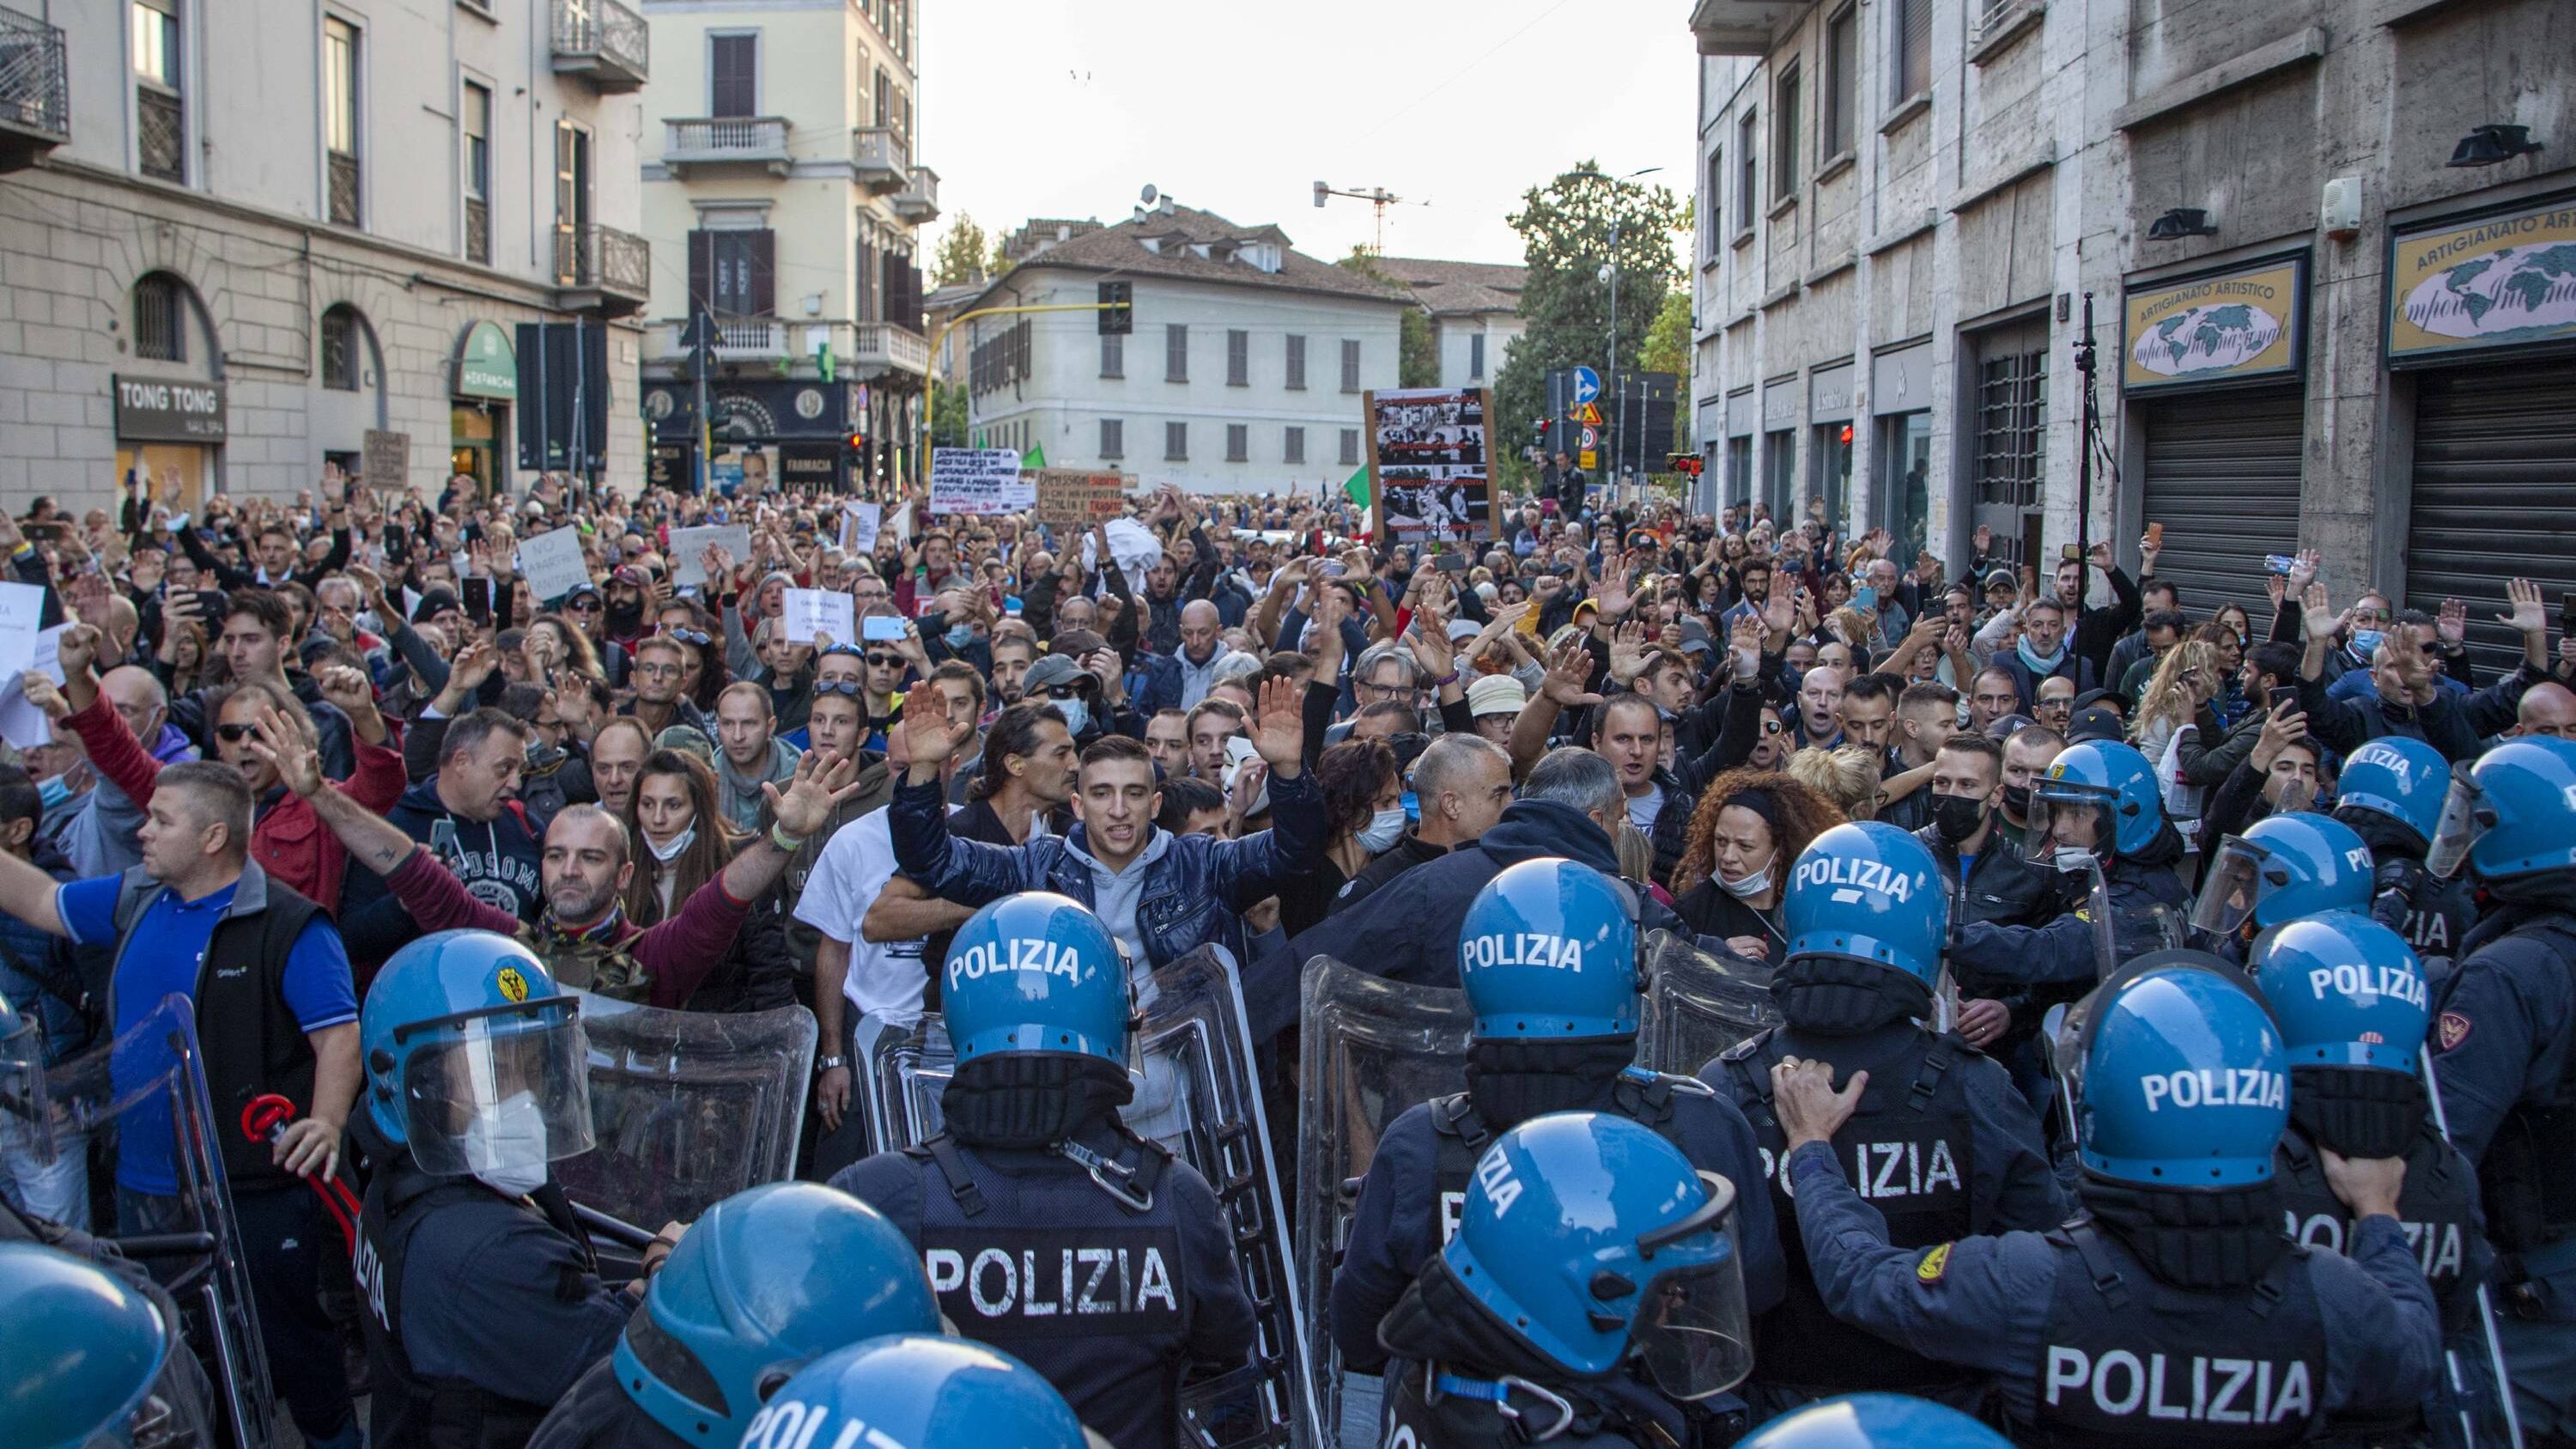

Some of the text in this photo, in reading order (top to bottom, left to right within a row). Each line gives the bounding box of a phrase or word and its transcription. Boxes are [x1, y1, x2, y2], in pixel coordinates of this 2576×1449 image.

[2417, 217, 2537, 271] ARTIGIANATO
[2140, 282, 2275, 323] ARTIGIANATO ARTISTICO
[120, 382, 217, 413] TONG TONG
[787, 459, 832, 472] FARMACIA
[1795, 857, 1910, 904] POLIZIA
[949, 938, 1080, 992] POLIZIA
[1462, 933, 1583, 974] POLIZIA
[2309, 965, 2427, 1012] POLIZIA
[2141, 1068, 2286, 1112] POLIZIA
[926, 1248, 1178, 1318] POLIZIA
[2045, 1344, 2312, 1424] POLIZIA
